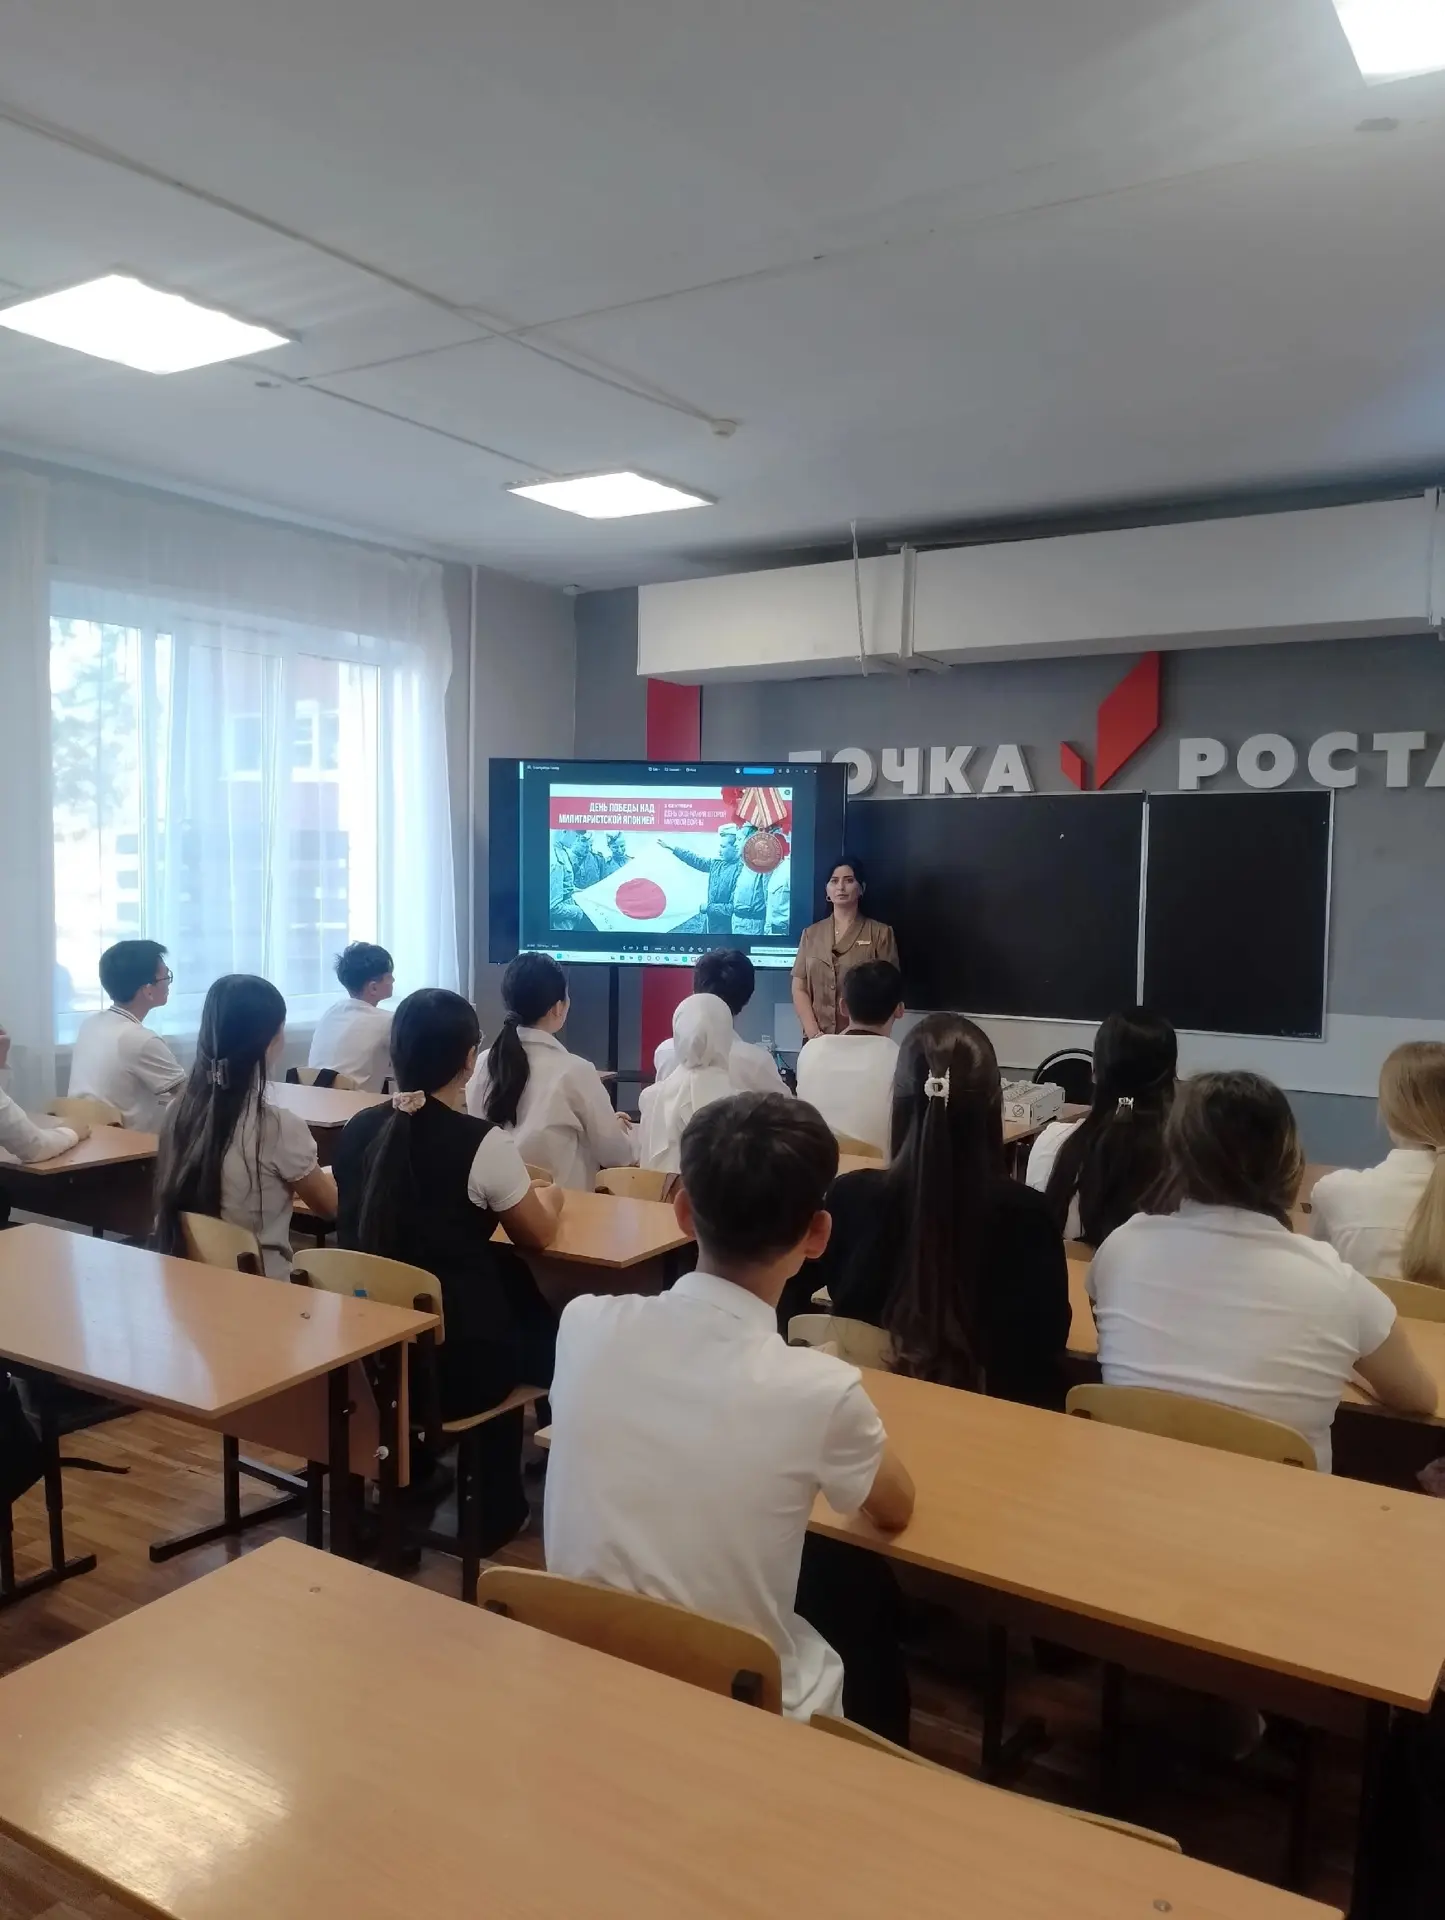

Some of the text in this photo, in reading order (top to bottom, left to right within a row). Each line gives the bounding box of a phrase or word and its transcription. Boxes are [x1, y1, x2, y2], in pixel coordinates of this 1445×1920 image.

[589, 802, 608, 813] ДЕНЬ
[609, 802, 639, 813] ПОБЕДЫ
[558, 813, 623, 824] МИЛИТАРИСТСКОЙ
